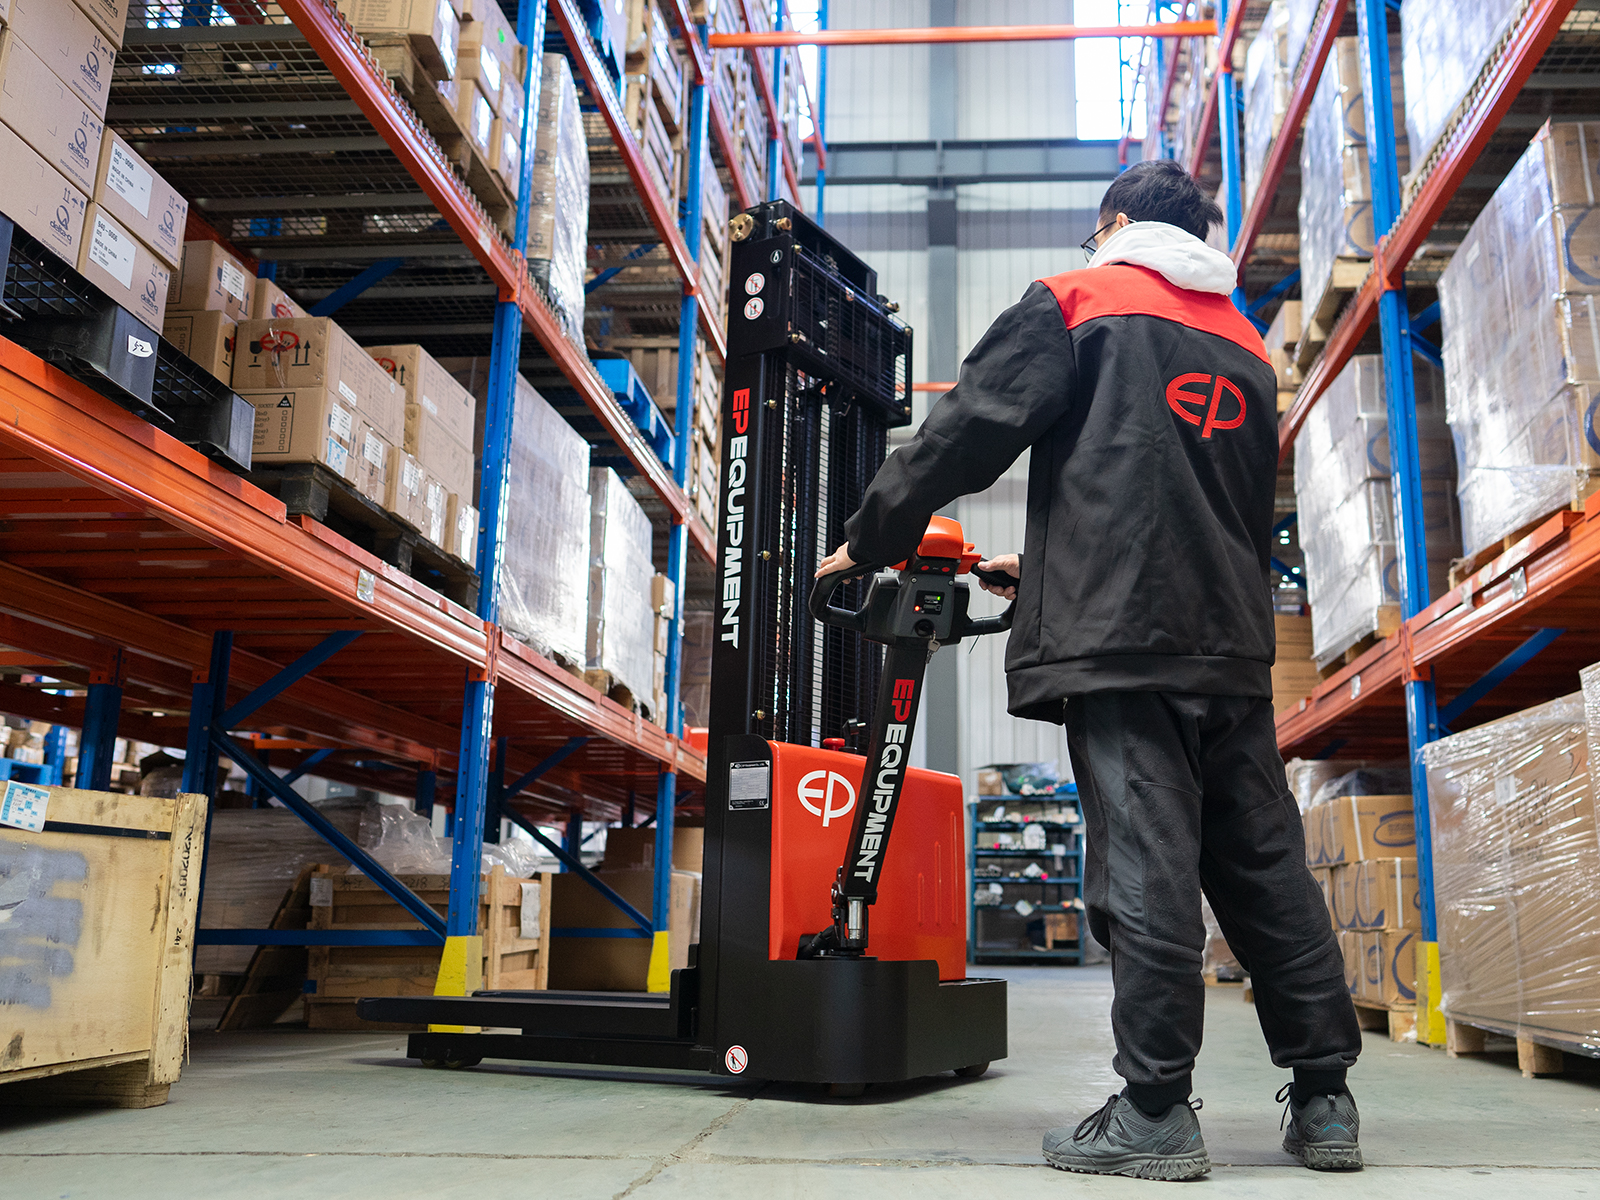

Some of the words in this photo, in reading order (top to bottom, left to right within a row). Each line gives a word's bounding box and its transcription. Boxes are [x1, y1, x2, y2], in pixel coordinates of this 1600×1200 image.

[80, 65, 101, 91] delta-q
[68, 142, 89, 168] delta-q
[50, 220, 72, 245] delta-q
[158, 224, 176, 245] delta-q
[141, 294, 158, 314] delta-q
[732, 388, 750, 434] EP
[1166, 372, 1246, 438] EP
[721, 435, 748, 650] EQUIPMENT
[892, 679, 915, 722] EP
[797, 770, 856, 827] EP
[854, 724, 908, 883] EQUIPMENT
